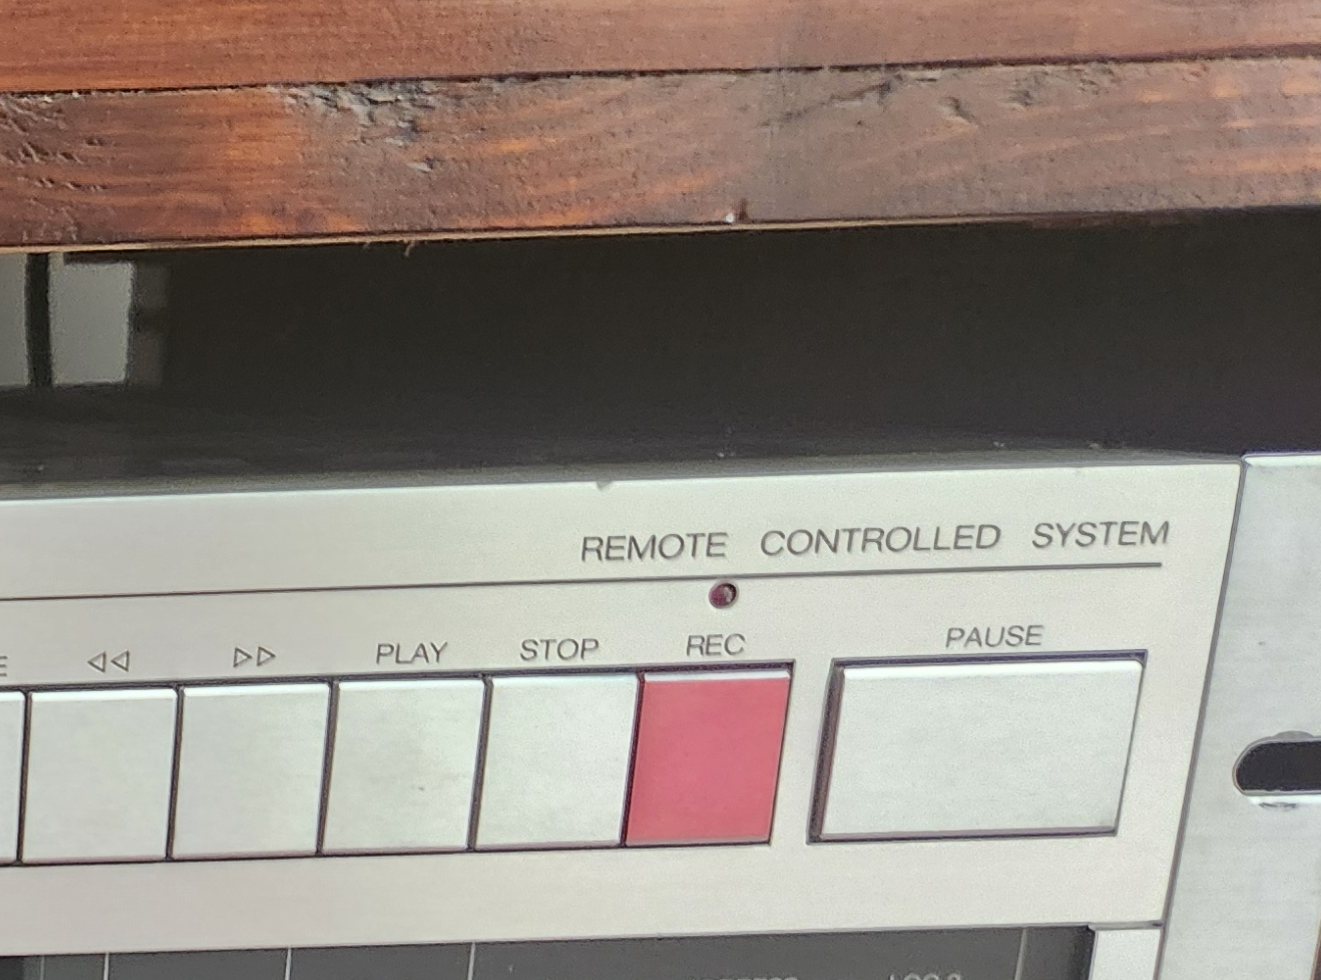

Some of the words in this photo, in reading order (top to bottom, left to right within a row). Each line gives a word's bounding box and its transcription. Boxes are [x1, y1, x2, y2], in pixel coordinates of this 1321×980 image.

[581, 531, 728, 562] REMOTE
[760, 524, 1002, 557] CONTROLLED
[1031, 520, 1170, 549] SYSTEM
[686, 633, 746, 657] REC
[945, 624, 1044, 648] PAUSE
[376, 642, 448, 665] PLAY
[519, 638, 600, 662] STOP
